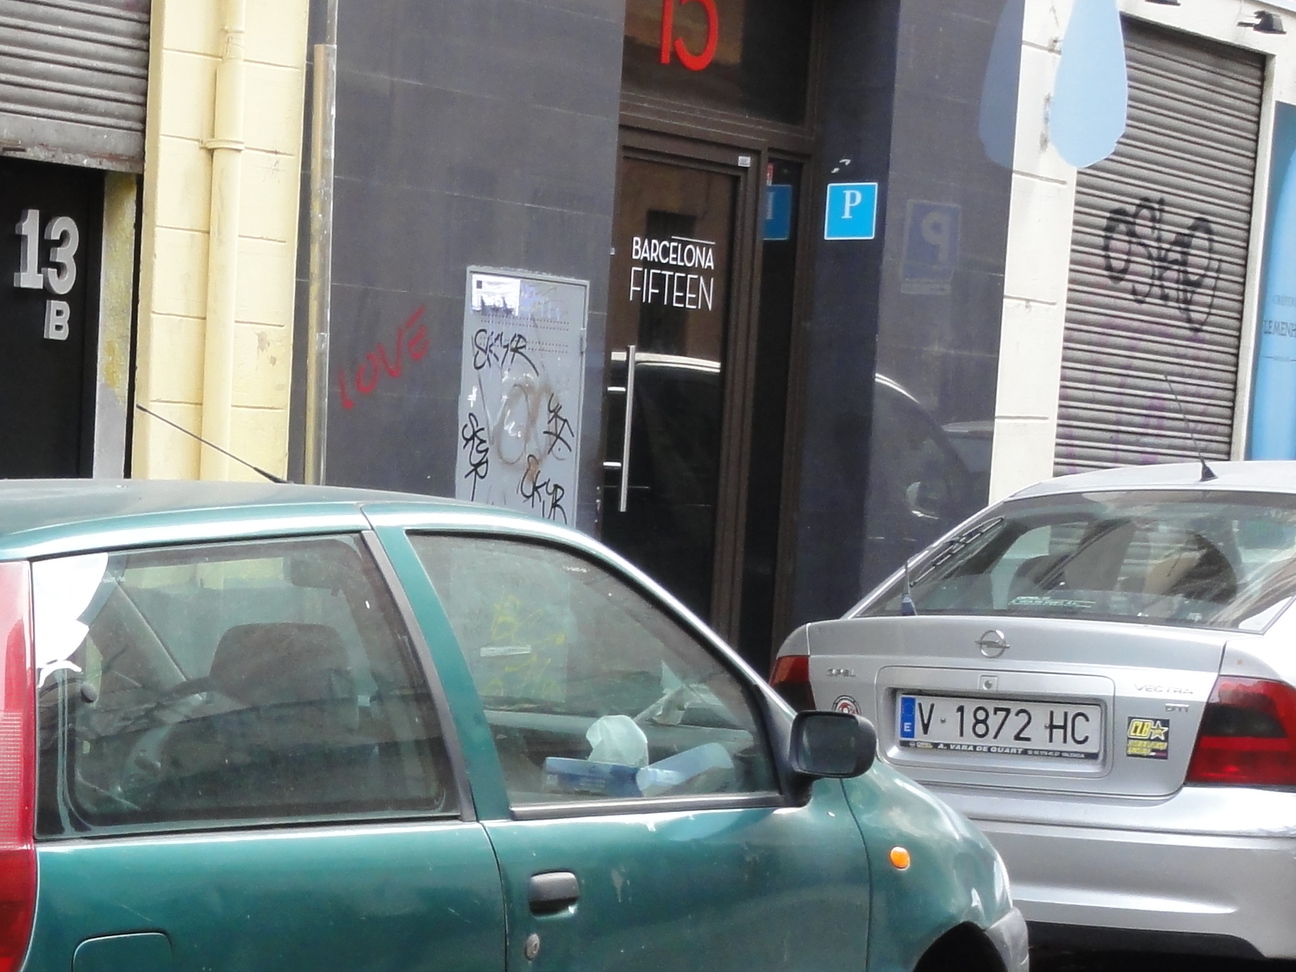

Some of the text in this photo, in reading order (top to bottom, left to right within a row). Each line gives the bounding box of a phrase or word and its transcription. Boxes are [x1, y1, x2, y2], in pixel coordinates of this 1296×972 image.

[841, 190, 862, 219] P
[13, 208, 80, 295] 13
[631, 236, 715, 270] BARCELONA
[629, 266, 714, 311] FIFTEEN
[43, 299, 71, 341] B
[917, 702, 1090, 745] V 1872 HC
[990, 746, 1024, 755] QUART
